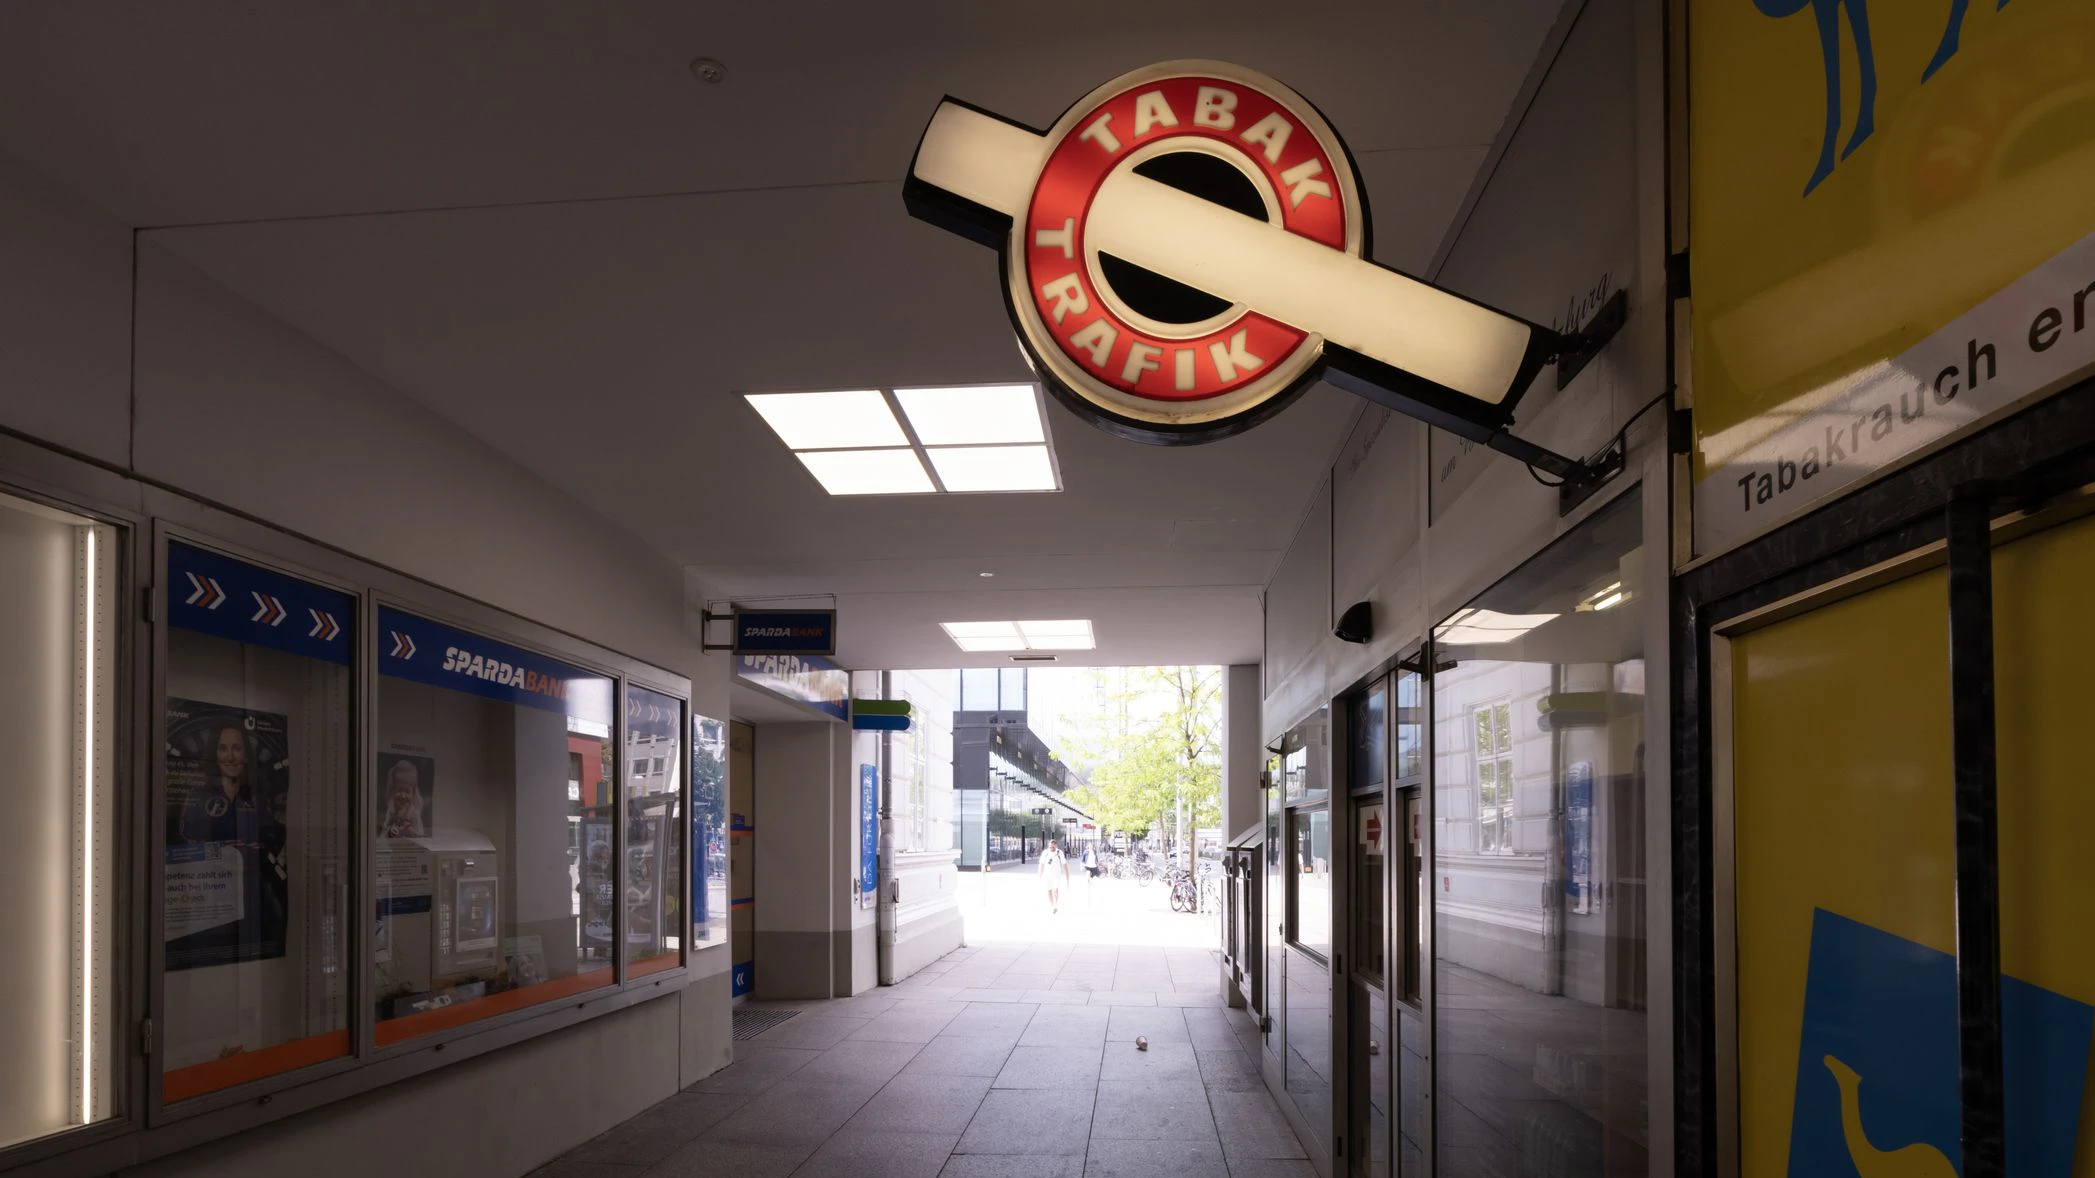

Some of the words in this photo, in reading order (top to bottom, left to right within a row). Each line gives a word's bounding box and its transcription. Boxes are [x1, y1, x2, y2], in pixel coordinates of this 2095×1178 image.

[1078, 86, 1333, 210] TABAK
[1036, 217, 1265, 391] TRAFIK
[1738, 339, 1996, 512] Tabakrauch
[744, 627, 824, 638] SPARDABANK
